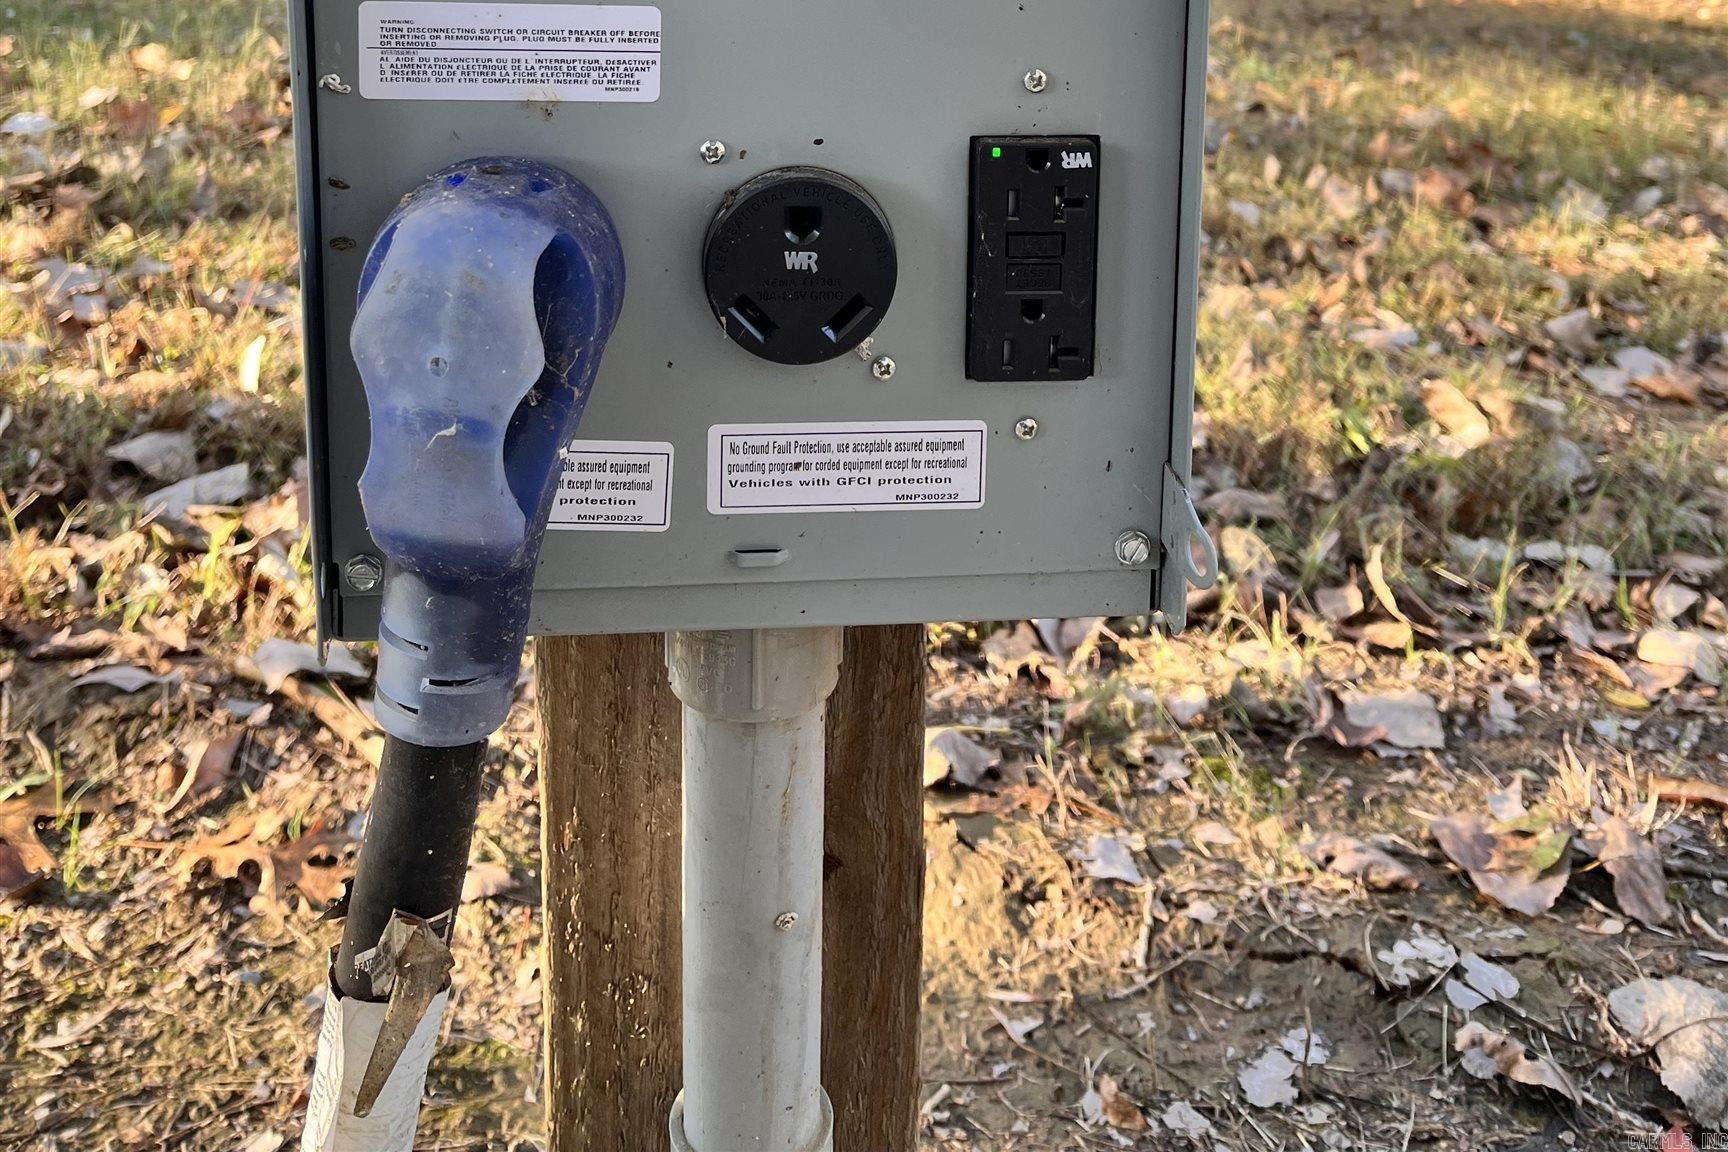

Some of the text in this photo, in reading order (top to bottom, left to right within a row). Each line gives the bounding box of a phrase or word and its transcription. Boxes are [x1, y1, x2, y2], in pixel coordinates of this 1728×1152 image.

[589, 35, 615, 43] FULLY
[629, 29, 661, 37] BEFORE
[395, 41, 437, 49] REMOVED
[1061, 150, 1093, 169] WR
[784, 251, 819, 274] WR
[730, 442, 740, 455] No
[742, 441, 769, 455] Ground
[772, 441, 791, 454] Fault
[837, 443, 850, 453] use
[852, 439, 892, 455] acceptable
[894, 438, 923, 452] assured
[925, 438, 964, 454] equipment
[577, 459, 607, 473] assured
[610, 460, 650, 476] equipment
[727, 460, 766, 476] grounding
[801, 459, 814, 472] for
[815, 458, 841, 471] corded
[842, 458, 883, 474] equipment
[885, 458, 909, 472] except
[911, 457, 922, 469] for
[924, 453, 967, 469] recreational
[567, 478, 592, 492] except
[594, 478, 605, 490] for
[607, 479, 653, 491] recreational
[729, 476, 951, 488] Vehicles with GFCI protection
[560, 497, 636, 506] protection
[896, 493, 959, 503] MNP300232
[577, 513, 644, 523] MNP300232
